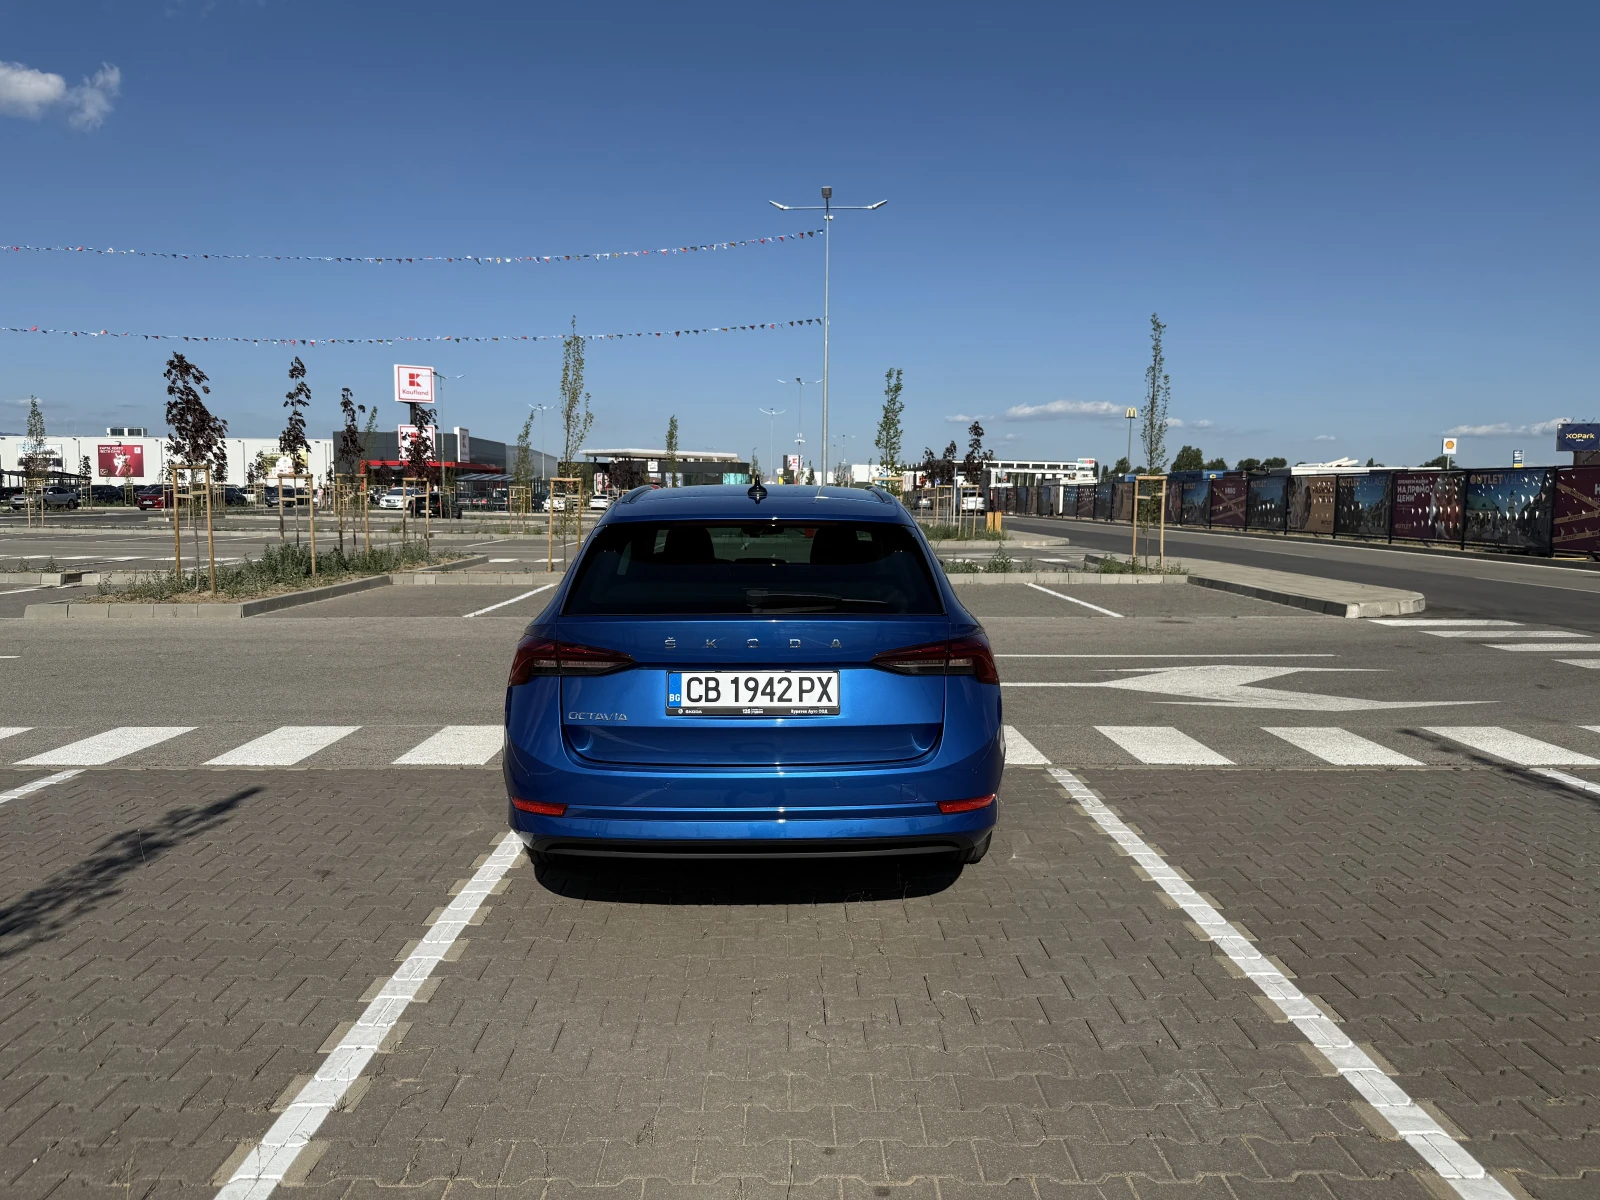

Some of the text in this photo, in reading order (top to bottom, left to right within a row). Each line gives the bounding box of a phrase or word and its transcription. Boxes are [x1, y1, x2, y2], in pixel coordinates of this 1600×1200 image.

[1470, 474, 1503, 484] OUTLET
[1397, 494, 1414, 503] ЦЕНИ
[664, 637, 842, 648] ŠKODA
[686, 676, 833, 703] CB 1942 PX
[568, 711, 628, 721] OCTAVIA
